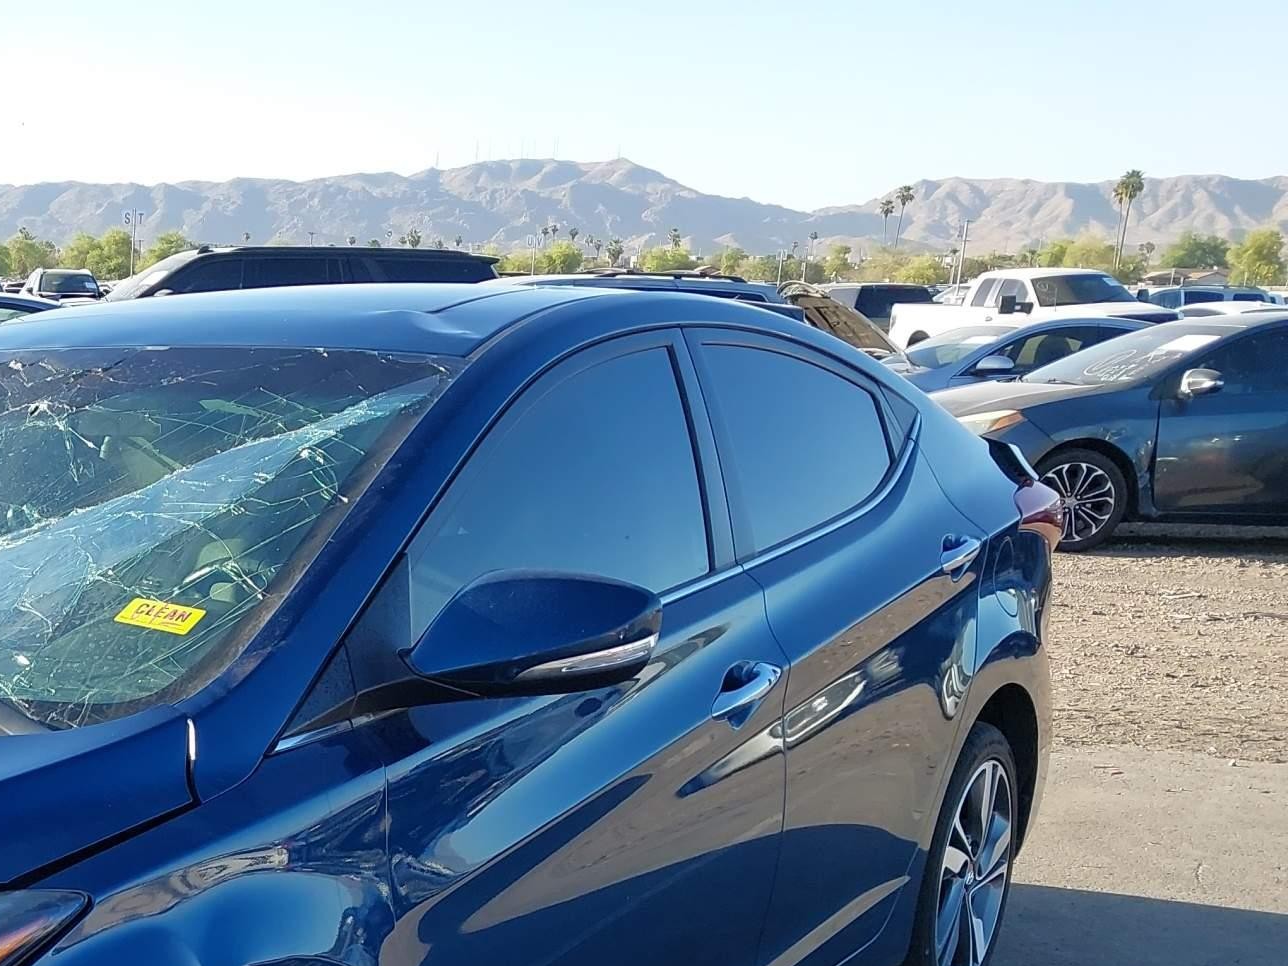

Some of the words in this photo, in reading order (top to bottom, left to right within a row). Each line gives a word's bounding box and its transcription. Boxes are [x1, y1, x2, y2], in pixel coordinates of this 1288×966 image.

[124, 211, 131, 225] S
[138, 212, 145, 225] T
[134, 602, 193, 623] CLEAN
